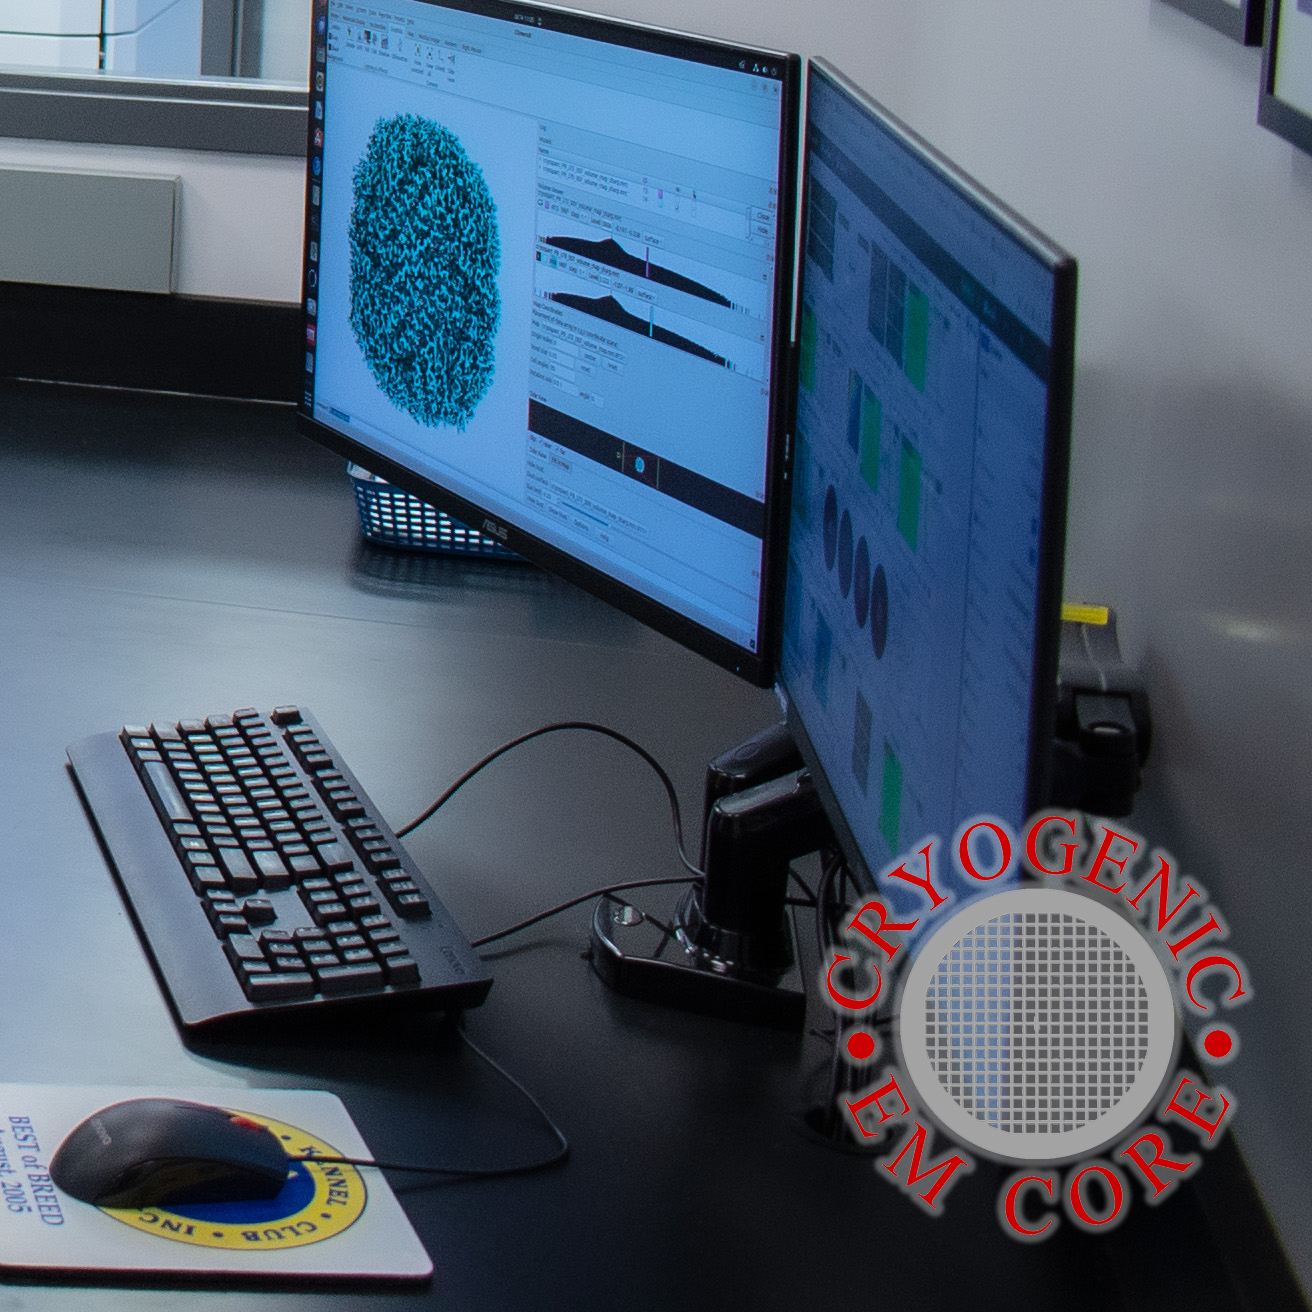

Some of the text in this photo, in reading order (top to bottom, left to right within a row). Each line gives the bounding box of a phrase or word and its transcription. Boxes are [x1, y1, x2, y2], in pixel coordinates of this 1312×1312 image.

[482, 518, 508, 540] ASUS
[8, 1115, 66, 1226] BEST of BREED
[299, 1145, 350, 1207] KNNEL
[1, 1181, 33, 1213] 2005
[240, 1220, 318, 1242] CLUB
